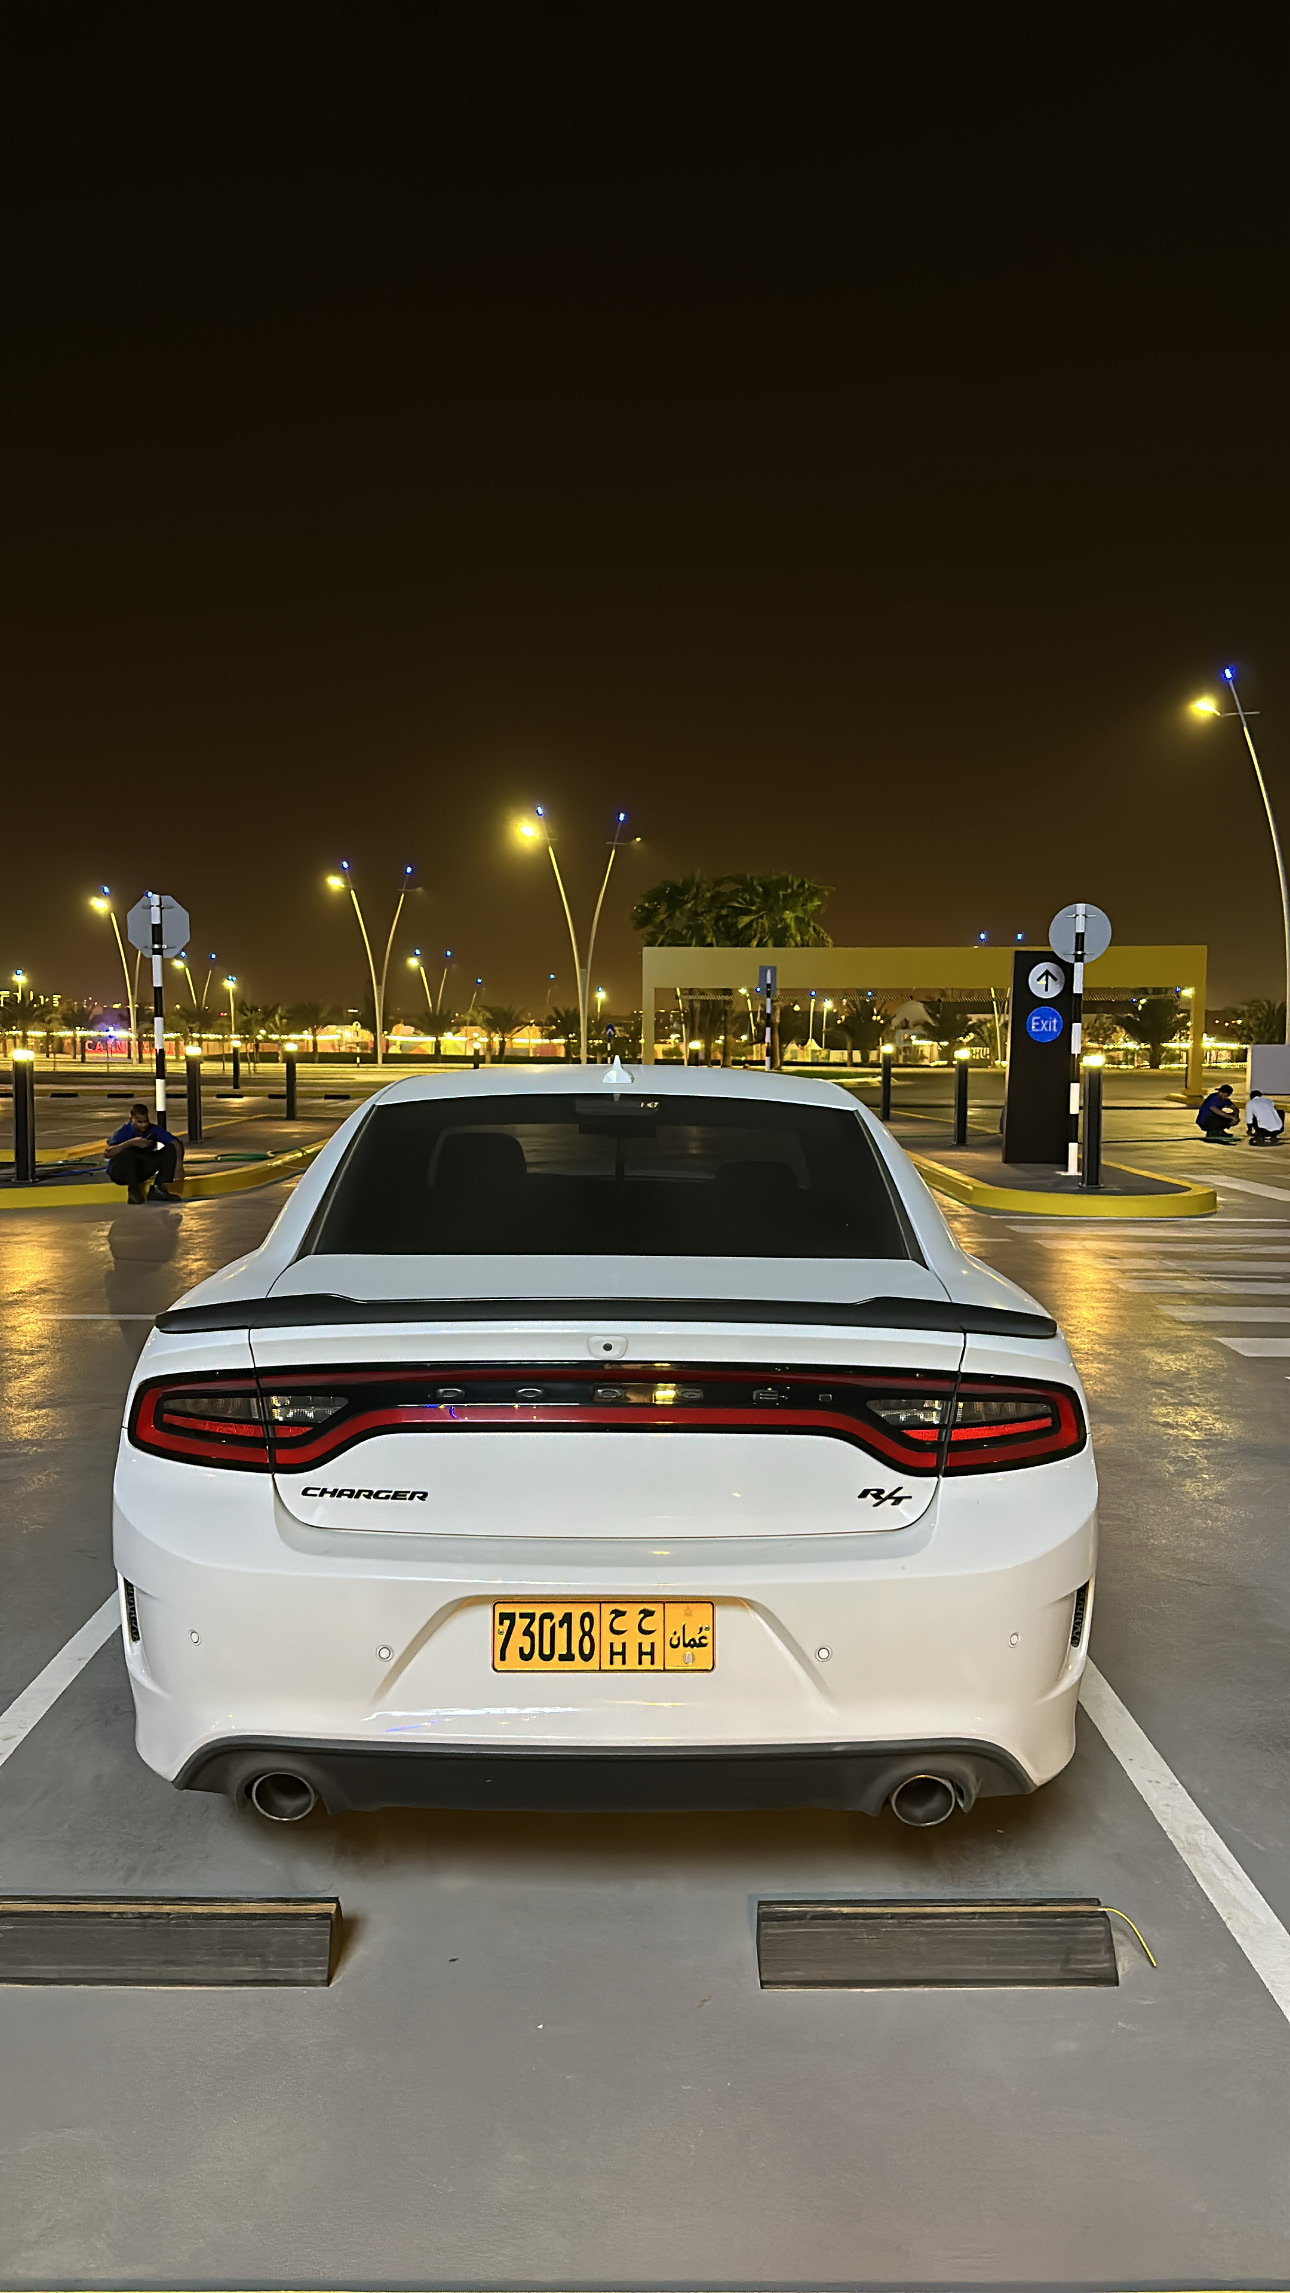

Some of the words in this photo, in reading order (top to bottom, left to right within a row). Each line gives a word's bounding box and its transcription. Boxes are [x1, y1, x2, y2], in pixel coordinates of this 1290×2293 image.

[1031, 1016, 1058, 1033] Exit
[301, 1486, 429, 1502] CHARGER
[857, 1486, 913, 1508] R/T
[498, 1611, 596, 1662] 73018
